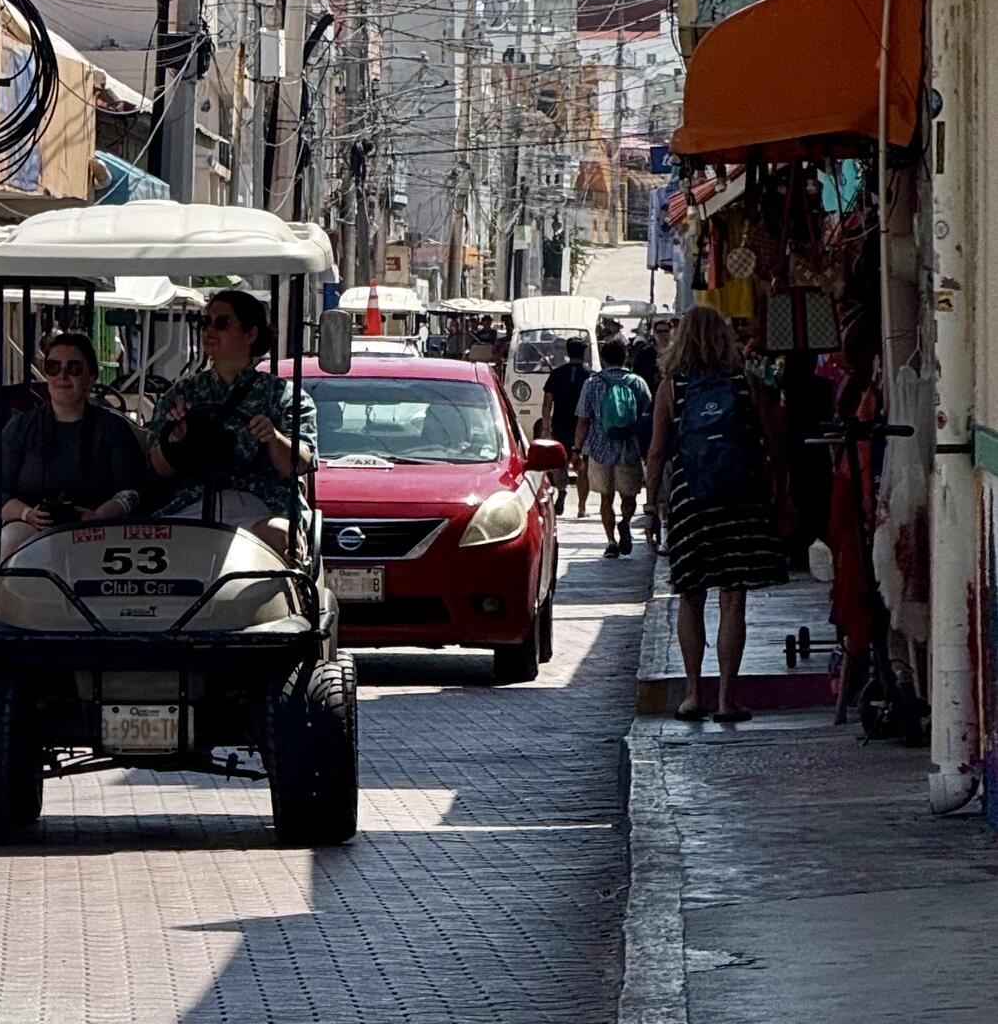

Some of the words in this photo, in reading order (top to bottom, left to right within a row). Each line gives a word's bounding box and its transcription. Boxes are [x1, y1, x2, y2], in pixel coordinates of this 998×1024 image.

[101, 546, 169, 575] 53
[100, 580, 139, 595] Club
[144, 580, 175, 595] Car
